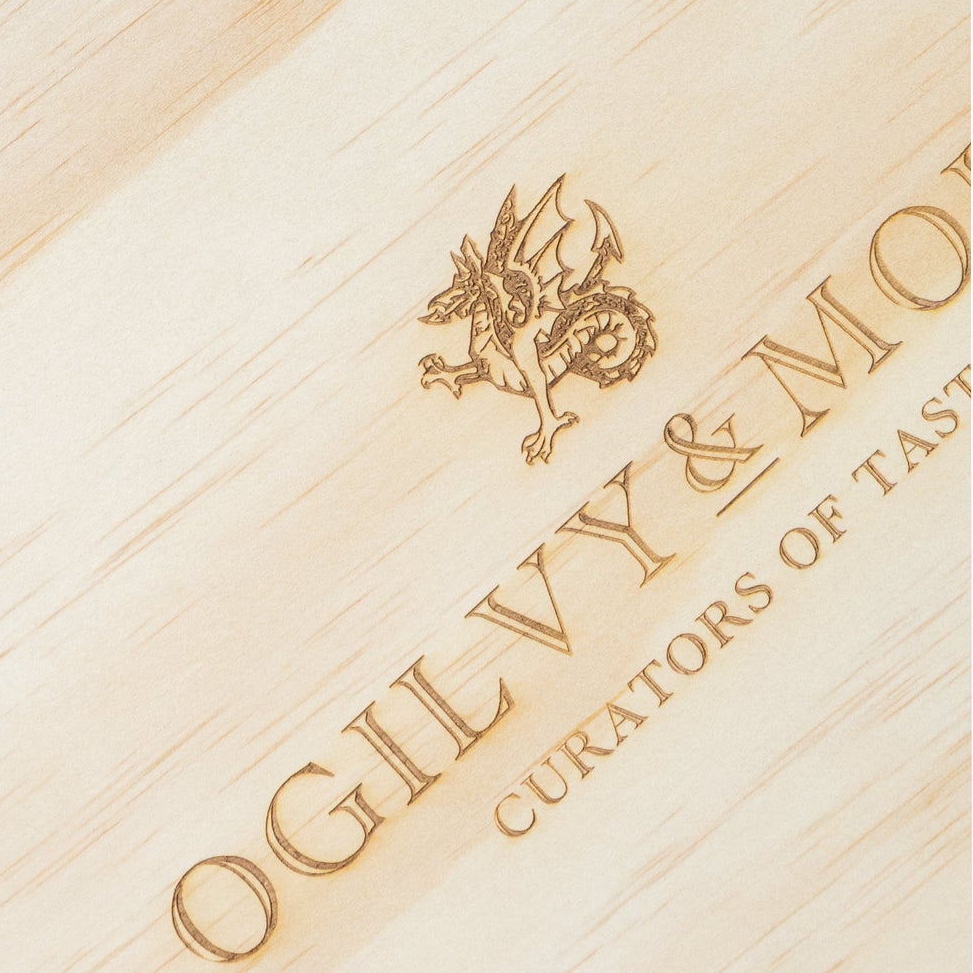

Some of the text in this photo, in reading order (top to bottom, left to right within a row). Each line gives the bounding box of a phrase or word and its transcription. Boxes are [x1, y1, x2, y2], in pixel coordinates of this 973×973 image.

[170, 461, 677, 963] OGILVY
[663, 412, 764, 494] &
[494, 571, 774, 838] CURATORS
[778, 493, 848, 570] OF
